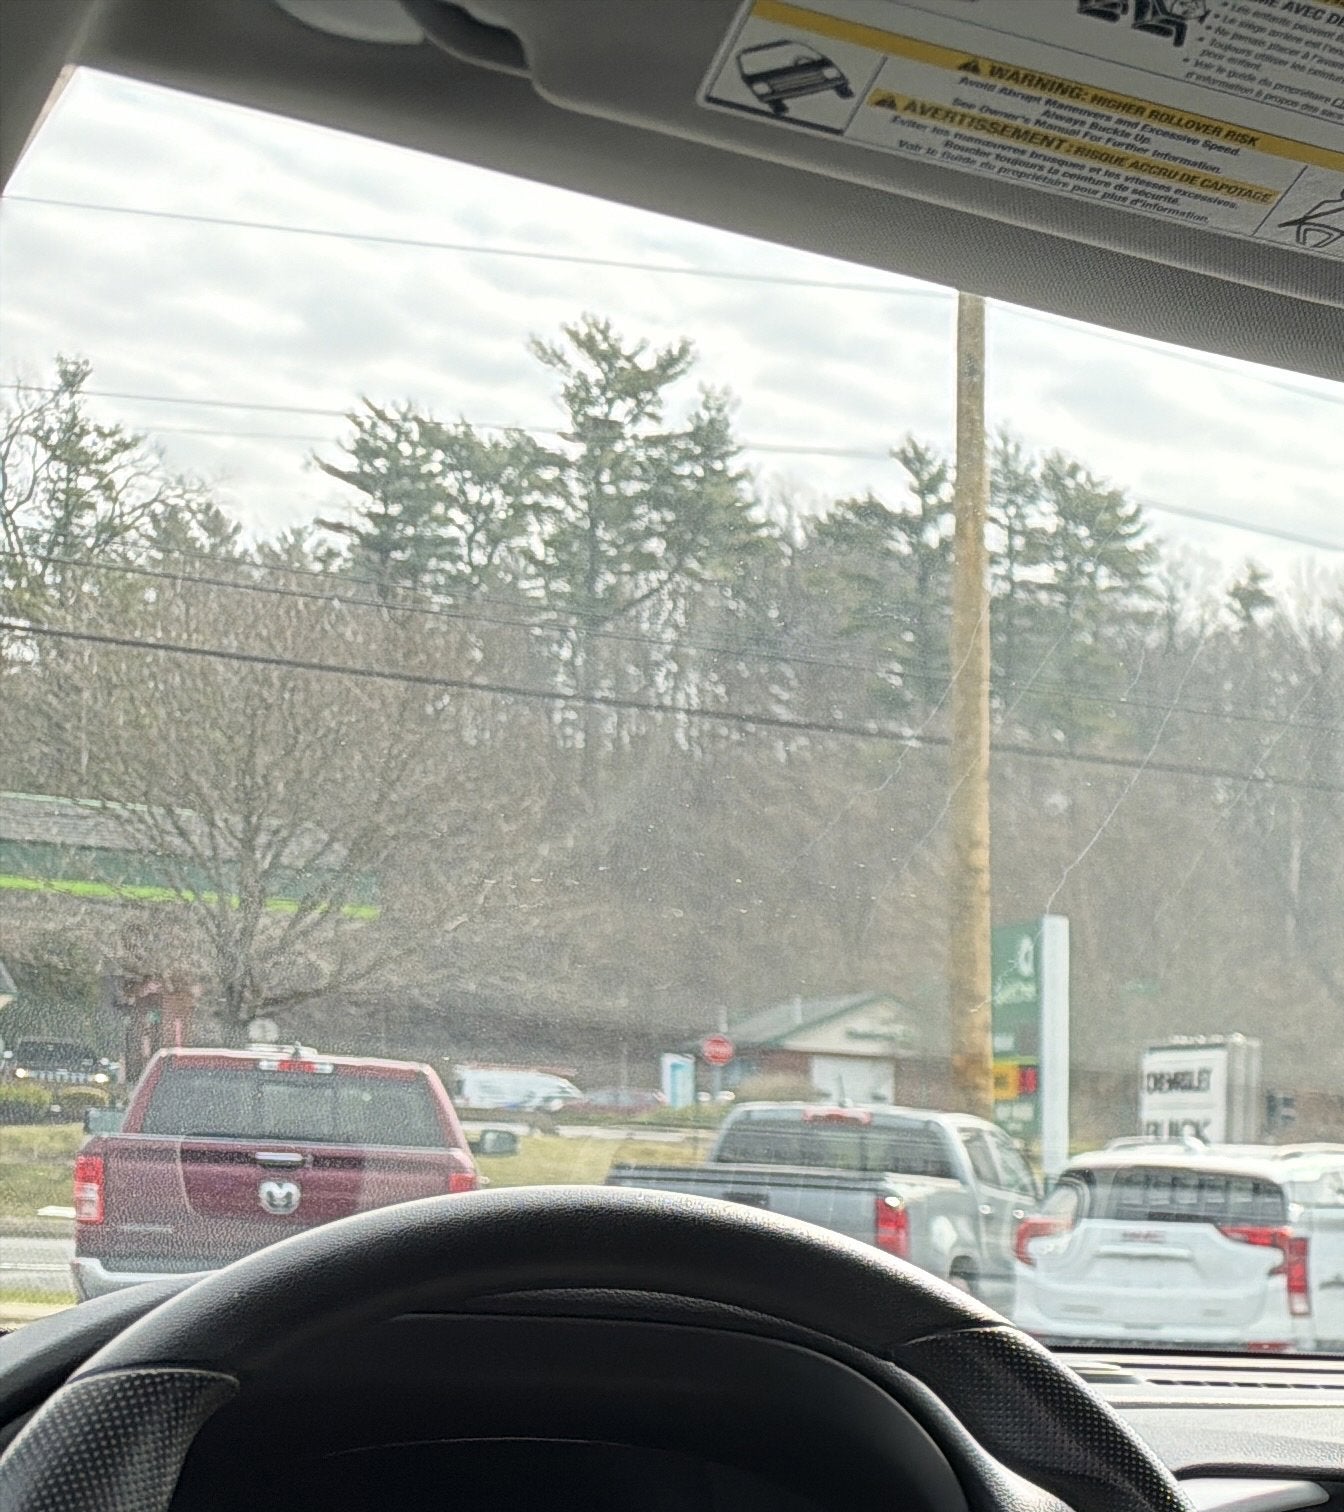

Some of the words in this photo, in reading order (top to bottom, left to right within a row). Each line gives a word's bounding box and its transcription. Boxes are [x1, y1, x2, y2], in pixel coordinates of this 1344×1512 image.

[1282, 0, 1327, 20] AVEC
[985, 64, 1091, 101] WARNING:
[1088, 93, 1147, 116] HIGHER
[1146, 109, 1225, 136] ROLLOVER
[1222, 129, 1260, 146] RISK
[1113, 116, 1140, 129] and
[1139, 123, 1202, 145] Excessive
[902, 99, 1067, 150] AVERTISSEMENT
[1071, 145, 1127, 166] RISQUE
[1126, 159, 1181, 180] ACCRU
[1178, 172, 1201, 185] DE
[1198, 177, 1272, 203] CAPOTAGE
